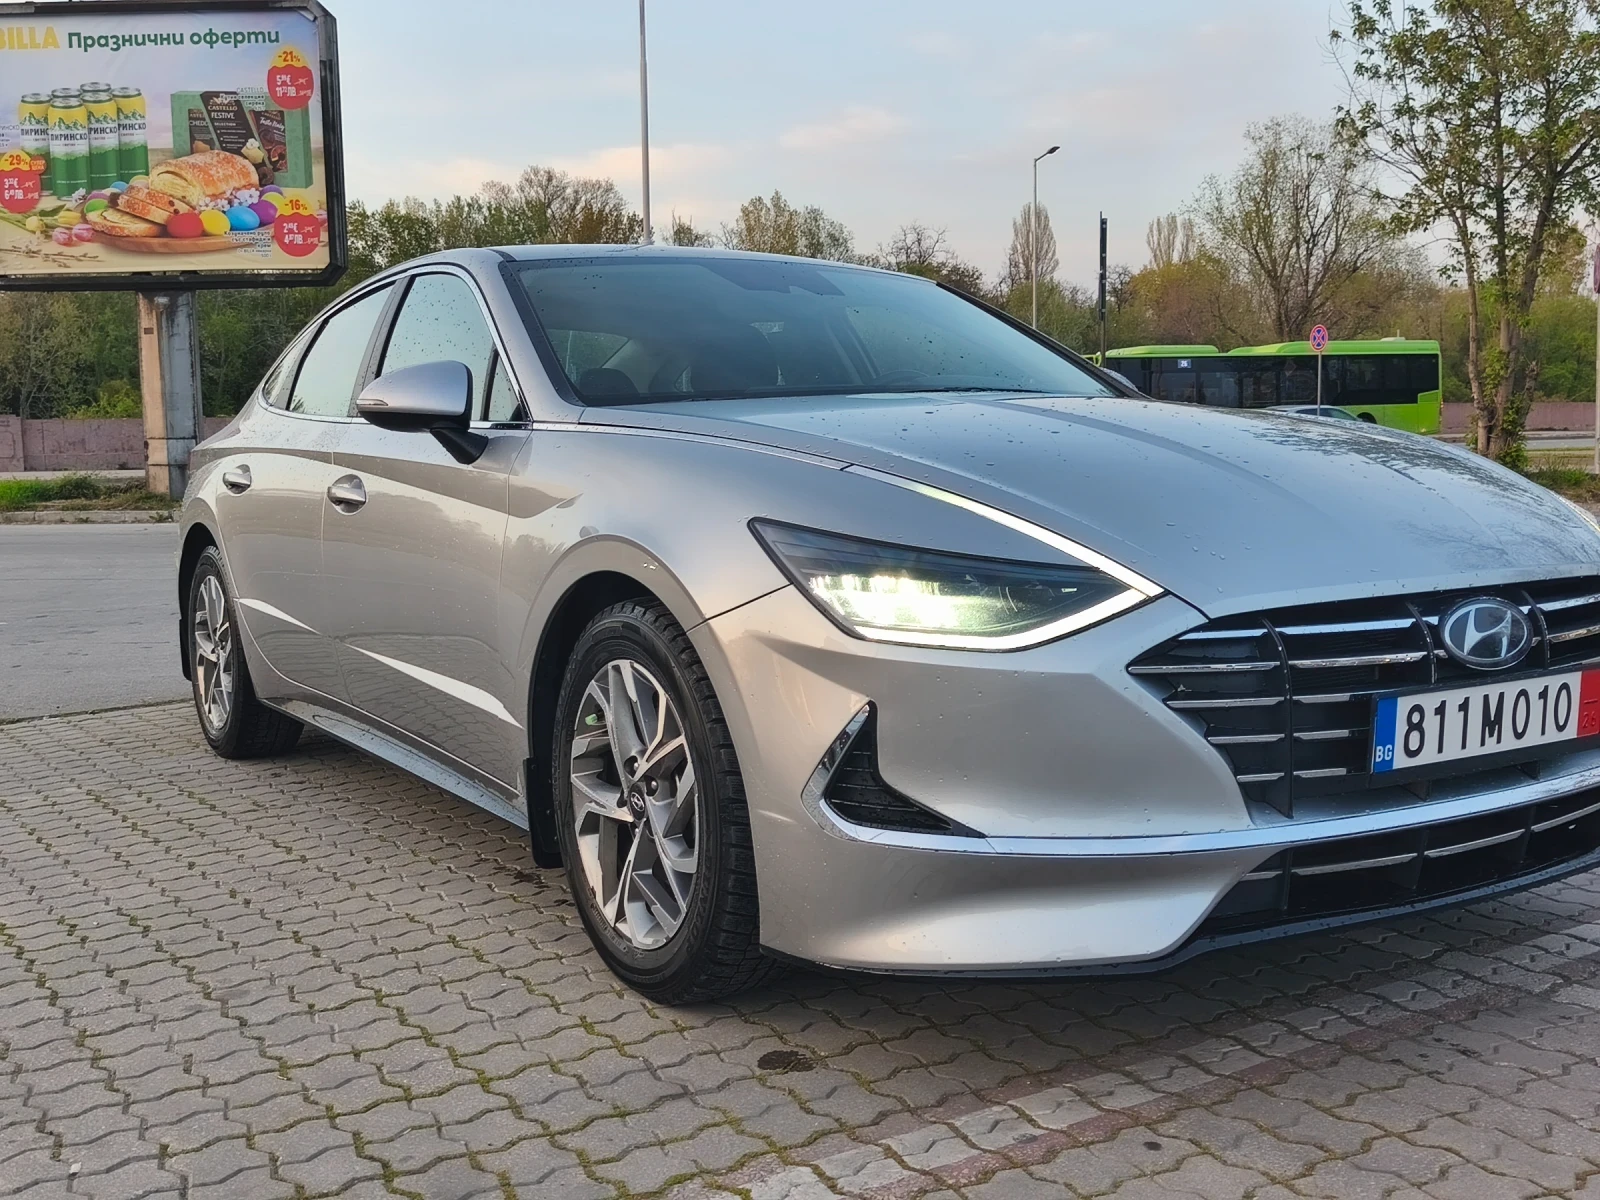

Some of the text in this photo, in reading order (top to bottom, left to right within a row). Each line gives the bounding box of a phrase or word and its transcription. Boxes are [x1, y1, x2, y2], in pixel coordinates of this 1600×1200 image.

[68, 28, 280, 53] Празнични оферти
[278, 50, 301, 63] -21%
[50, 132, 88, 142] ПИРИНСКО
[4, 154, 29, 166] -29%
[284, 199, 308, 211] -16%
[1403, 682, 1572, 758] 811M010
[1375, 744, 1394, 763] BG
